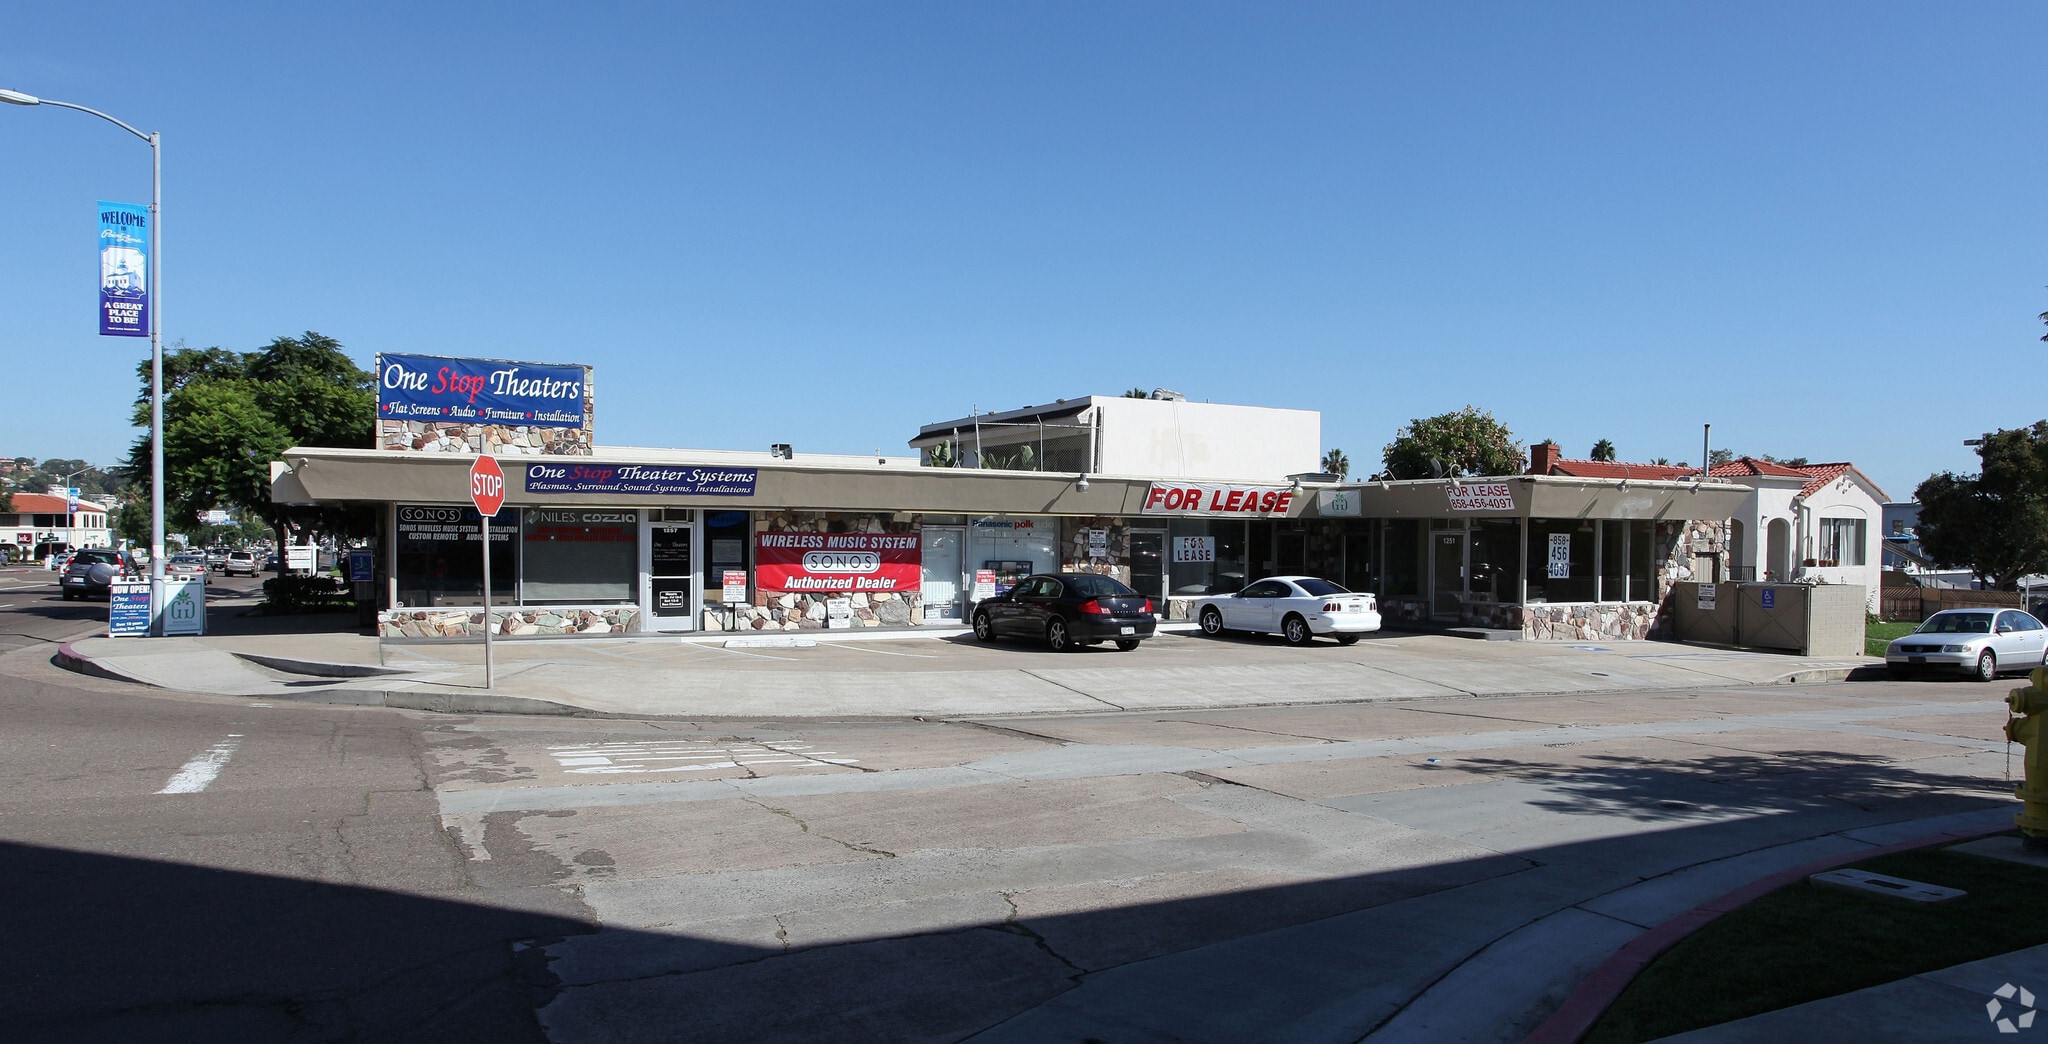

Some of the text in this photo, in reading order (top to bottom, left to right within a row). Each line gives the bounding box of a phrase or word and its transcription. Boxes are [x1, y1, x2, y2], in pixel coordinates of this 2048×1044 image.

[101, 210, 145, 228] WELCOME
[113, 302, 143, 310] GREAT
[109, 309, 139, 317] PLACE
[109, 316, 138, 325] TO BE!
[384, 363, 581, 404] One Stop Theaters
[388, 401, 580, 423] Flat Screens Audio Furniture Installation
[529, 464, 756, 485] One Stop Theater Systems
[473, 472, 503, 498] STOP
[529, 481, 751, 494] Plasmas, Surround Sound Systems, Installations
[1446, 485, 1510, 498] FOR LEASE
[1146, 487, 1293, 513] FOR LEASE
[1451, 498, 1512, 509] 858-456-4097
[405, 509, 456, 520] SONOS
[541, 511, 576, 522] NILES
[399, 524, 417, 532] SONOS
[417, 524, 442, 532] WIRELESS
[442, 525, 459, 533] MUSIC
[459, 525, 478, 533] SYSTEM
[972, 519, 1013, 528] Panasonic
[1014, 519, 1034, 530] polk
[408, 532, 432, 540] CUSTOM
[761, 534, 823, 548] WIRELESS
[827, 536, 867, 549] MUSIC
[871, 537, 917, 549] SYSTEM
[1184, 537, 1204, 549] FOR
[1177, 549, 1211, 561] LEASE
[1551, 547, 1567, 561] 456
[811, 555, 872, 569] SONOS
[1548, 562, 1569, 577] 4097
[784, 575, 897, 589] Authorized Dealer
[112, 585, 150, 594] NOW OPEN!
